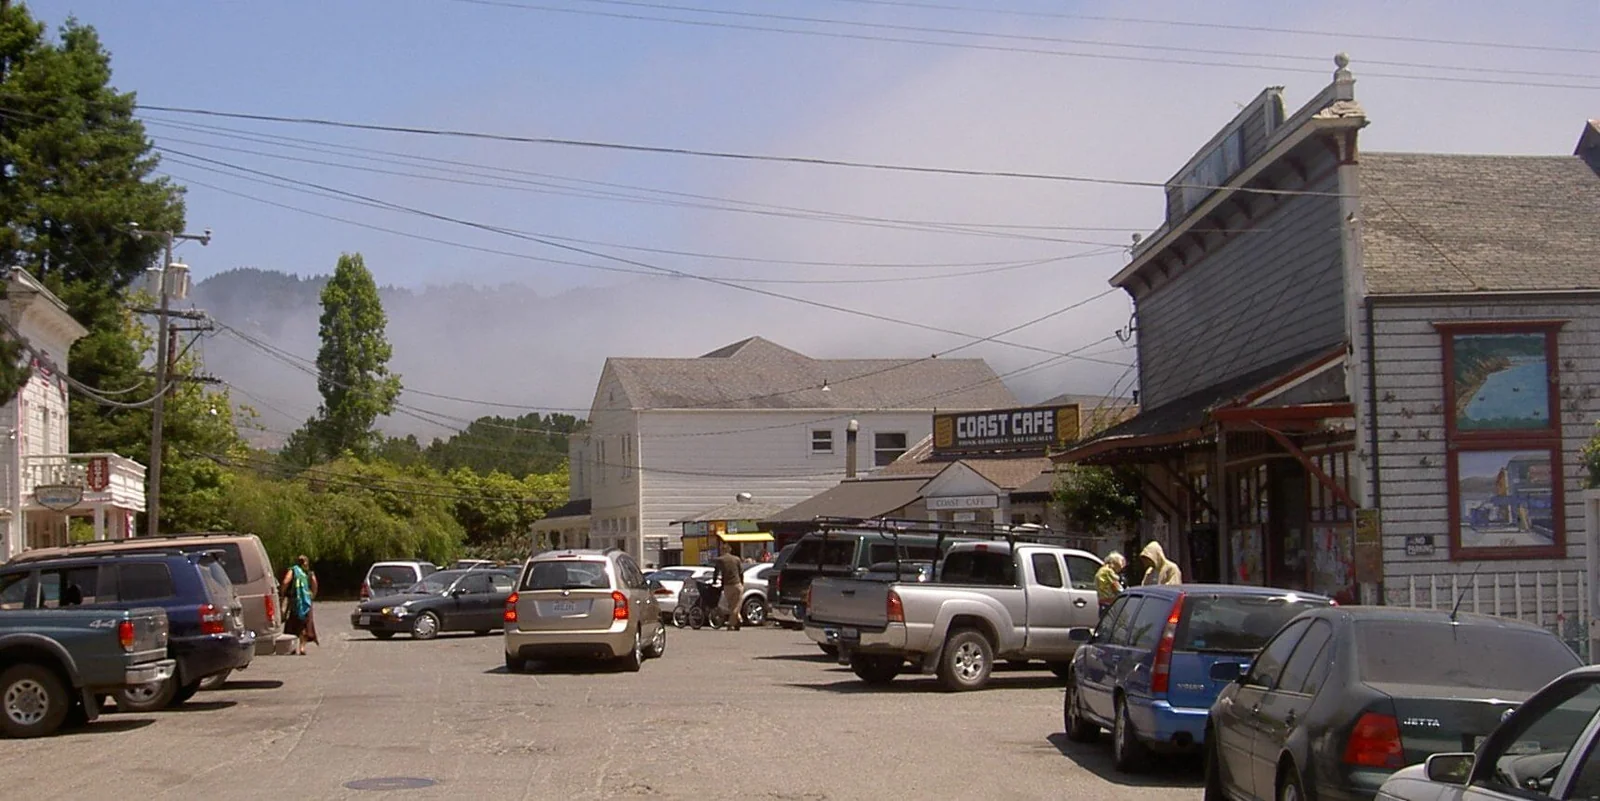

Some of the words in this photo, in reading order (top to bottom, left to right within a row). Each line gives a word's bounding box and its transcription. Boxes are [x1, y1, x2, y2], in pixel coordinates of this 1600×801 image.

[957, 414, 1008, 438] COAST
[1012, 411, 1053, 434] CAFE
[936, 498, 959, 507] COAST
[966, 497, 985, 506] CAFE
[1415, 537, 1426, 545] NO
[1407, 545, 1433, 555] PARKING
[1403, 717, 1440, 727] JETTA
